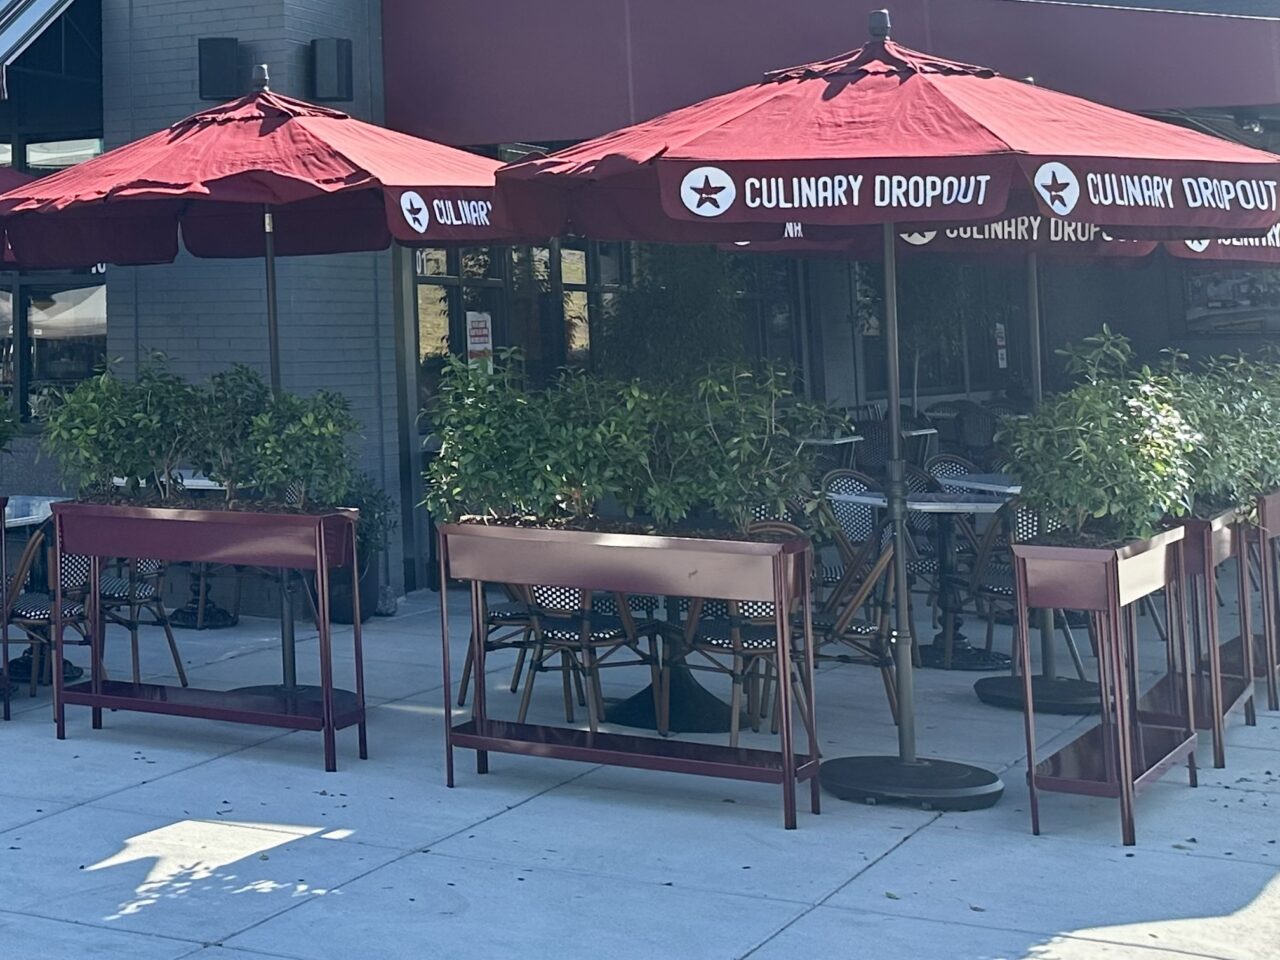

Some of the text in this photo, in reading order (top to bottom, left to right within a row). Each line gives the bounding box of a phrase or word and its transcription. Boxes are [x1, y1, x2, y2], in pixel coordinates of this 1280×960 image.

[745, 174, 991, 208] CULINARY DROPOUT
[1086, 172, 1278, 212] CULINARY DROPOUT
